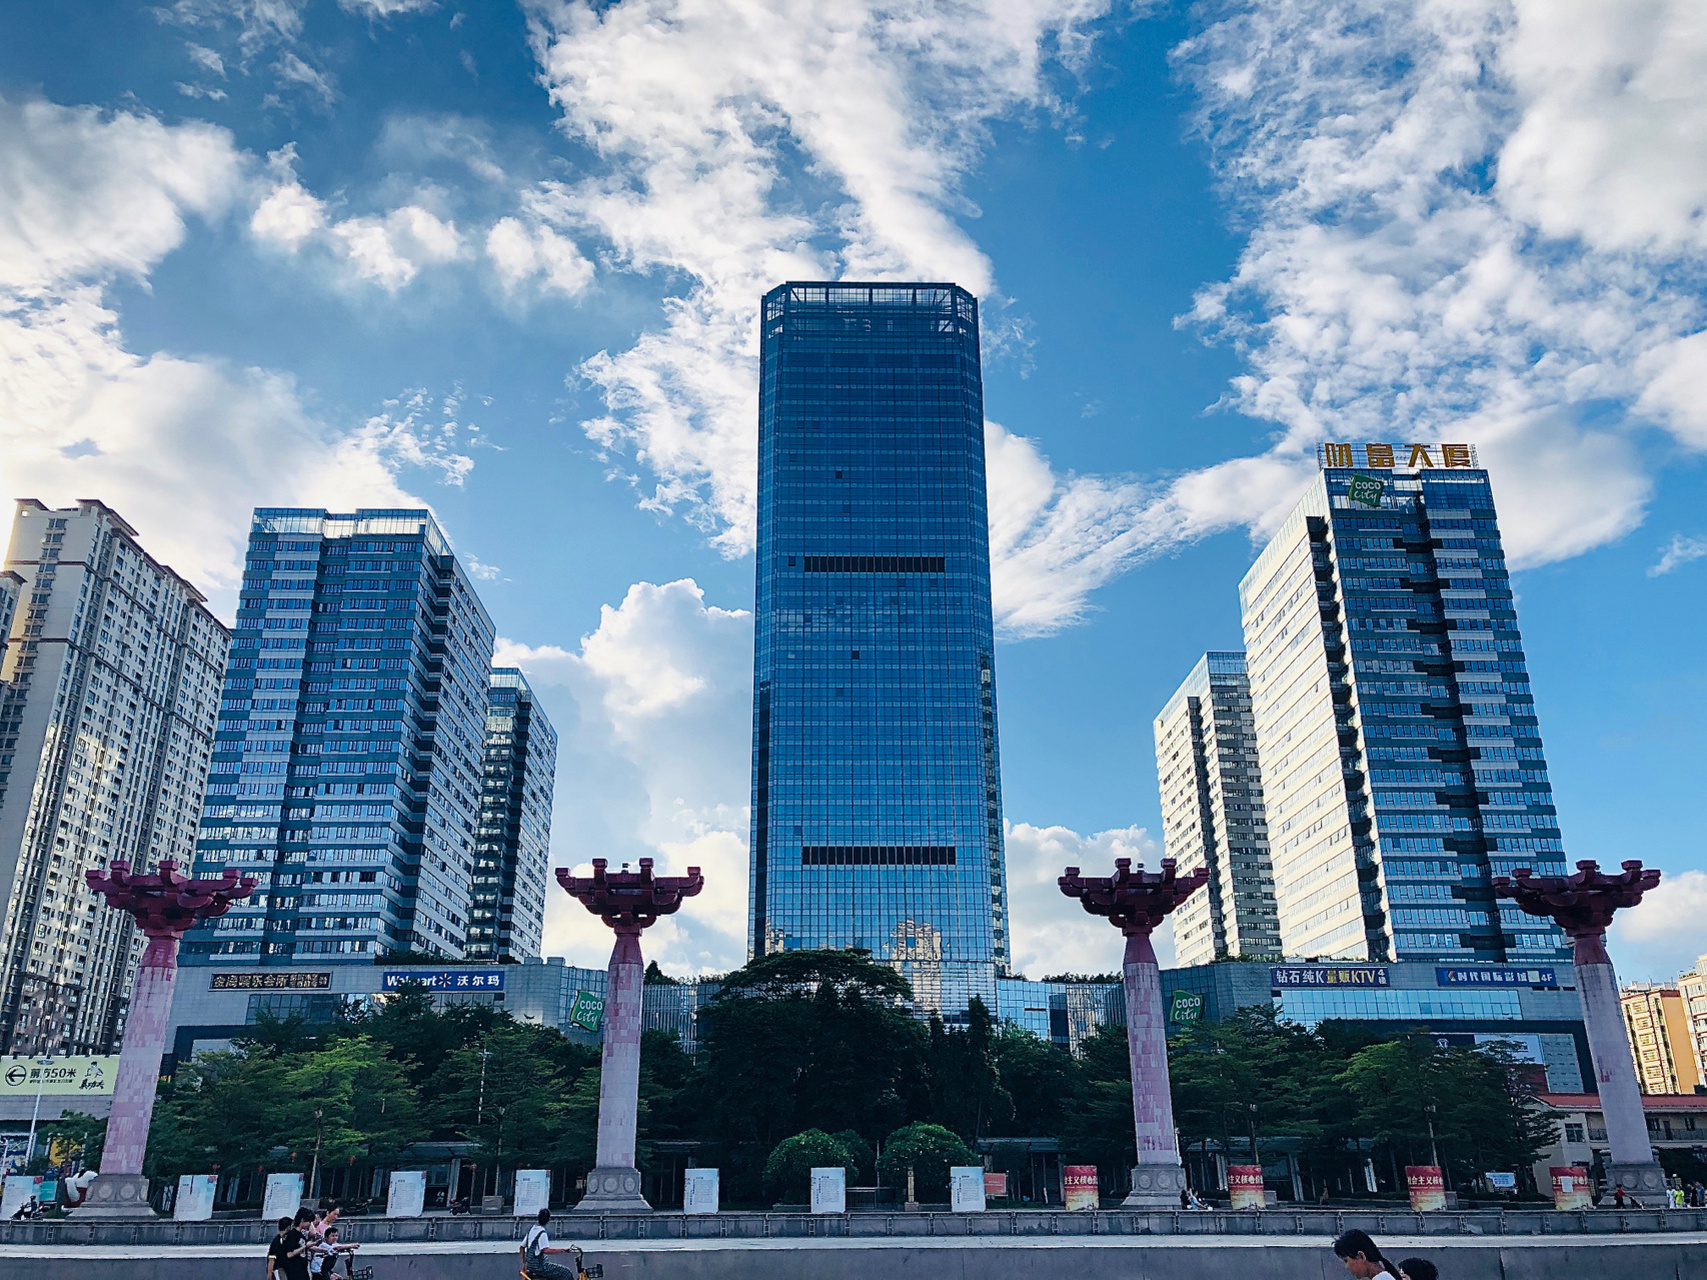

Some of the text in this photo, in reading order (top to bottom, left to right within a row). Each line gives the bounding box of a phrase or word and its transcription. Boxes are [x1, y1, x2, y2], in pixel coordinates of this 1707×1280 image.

[1325, 443, 1472, 467] 财富大厦
[1355, 481, 1381, 490] COCO
[457, 975, 500, 986] 沃尔玛
[1541, 974, 1553, 982] 4F
[580, 1000, 602, 1010] COCO
[1176, 998, 1200, 1008] COCO
[577, 1010, 598, 1027] City
